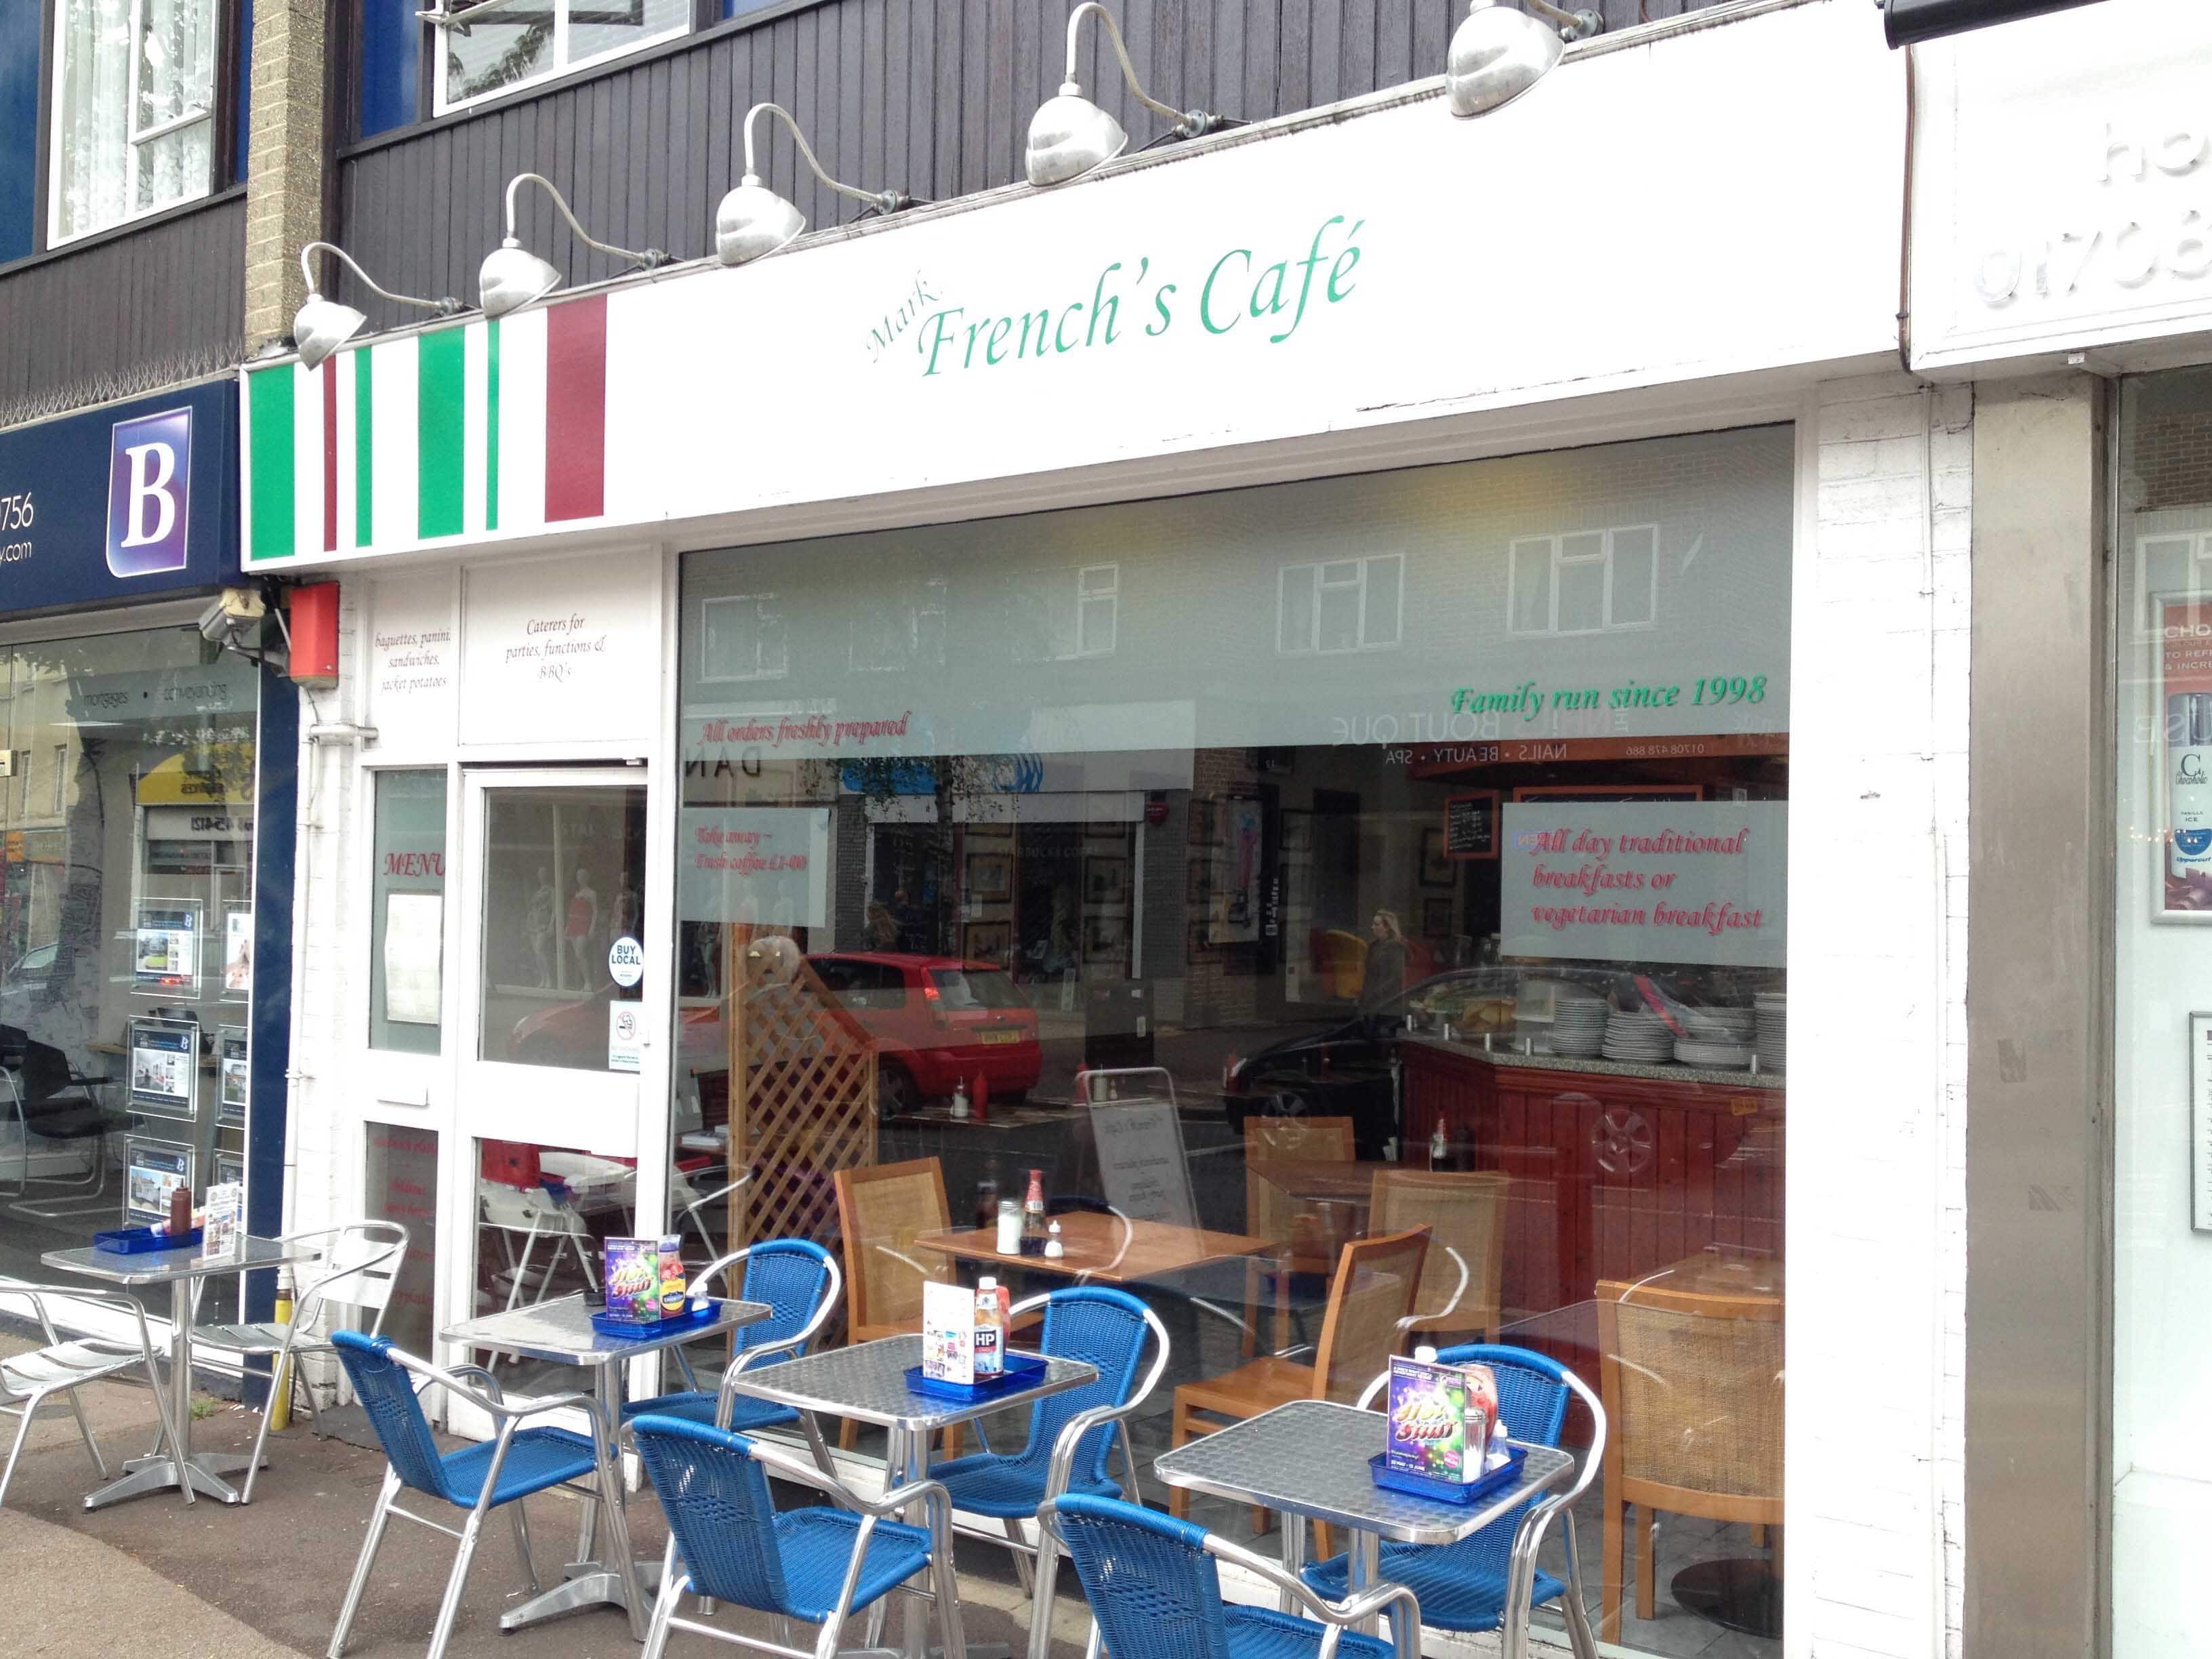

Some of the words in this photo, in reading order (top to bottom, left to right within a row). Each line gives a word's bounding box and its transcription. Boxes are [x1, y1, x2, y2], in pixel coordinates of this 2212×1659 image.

[918, 256, 1177, 377] French's
[1200, 214, 1366, 345] Café
[866, 268, 943, 364] Mark
[121, 443, 176, 548] B
[526, 618, 567, 636] Caterers
[567, 613, 586, 636] for
[374, 632, 418, 651] baguettes,
[505, 644, 541, 664] parties,
[542, 639, 592, 661] functions
[379, 674, 407, 697] jacket
[409, 676, 448, 695] potatoes
[1450, 680, 1546, 721] Family
[1551, 687, 1600, 711] run
[1607, 679, 1680, 710] since
[1690, 674, 1768, 707] 1998
[83, 690, 129, 710] mortgages
[699, 718, 726, 744] All
[727, 715, 774, 741] orders
[773, 714, 832, 748] freshly
[833, 710, 912, 745] prepared
[1529, 827, 1572, 857] All
[1572, 828, 1612, 861] day
[1618, 827, 1750, 855] traditional
[383, 852, 445, 877] MENU
[1532, 863, 1645, 897] breakfasts
[1650, 871, 1679, 890] or
[1530, 902, 1646, 932] vegetarian
[1652, 901, 1764, 937] breakfast
[611, 954, 641, 966] LOCAL
[617, 944, 636, 955] BUY
[975, 1332, 996, 1347] HP
